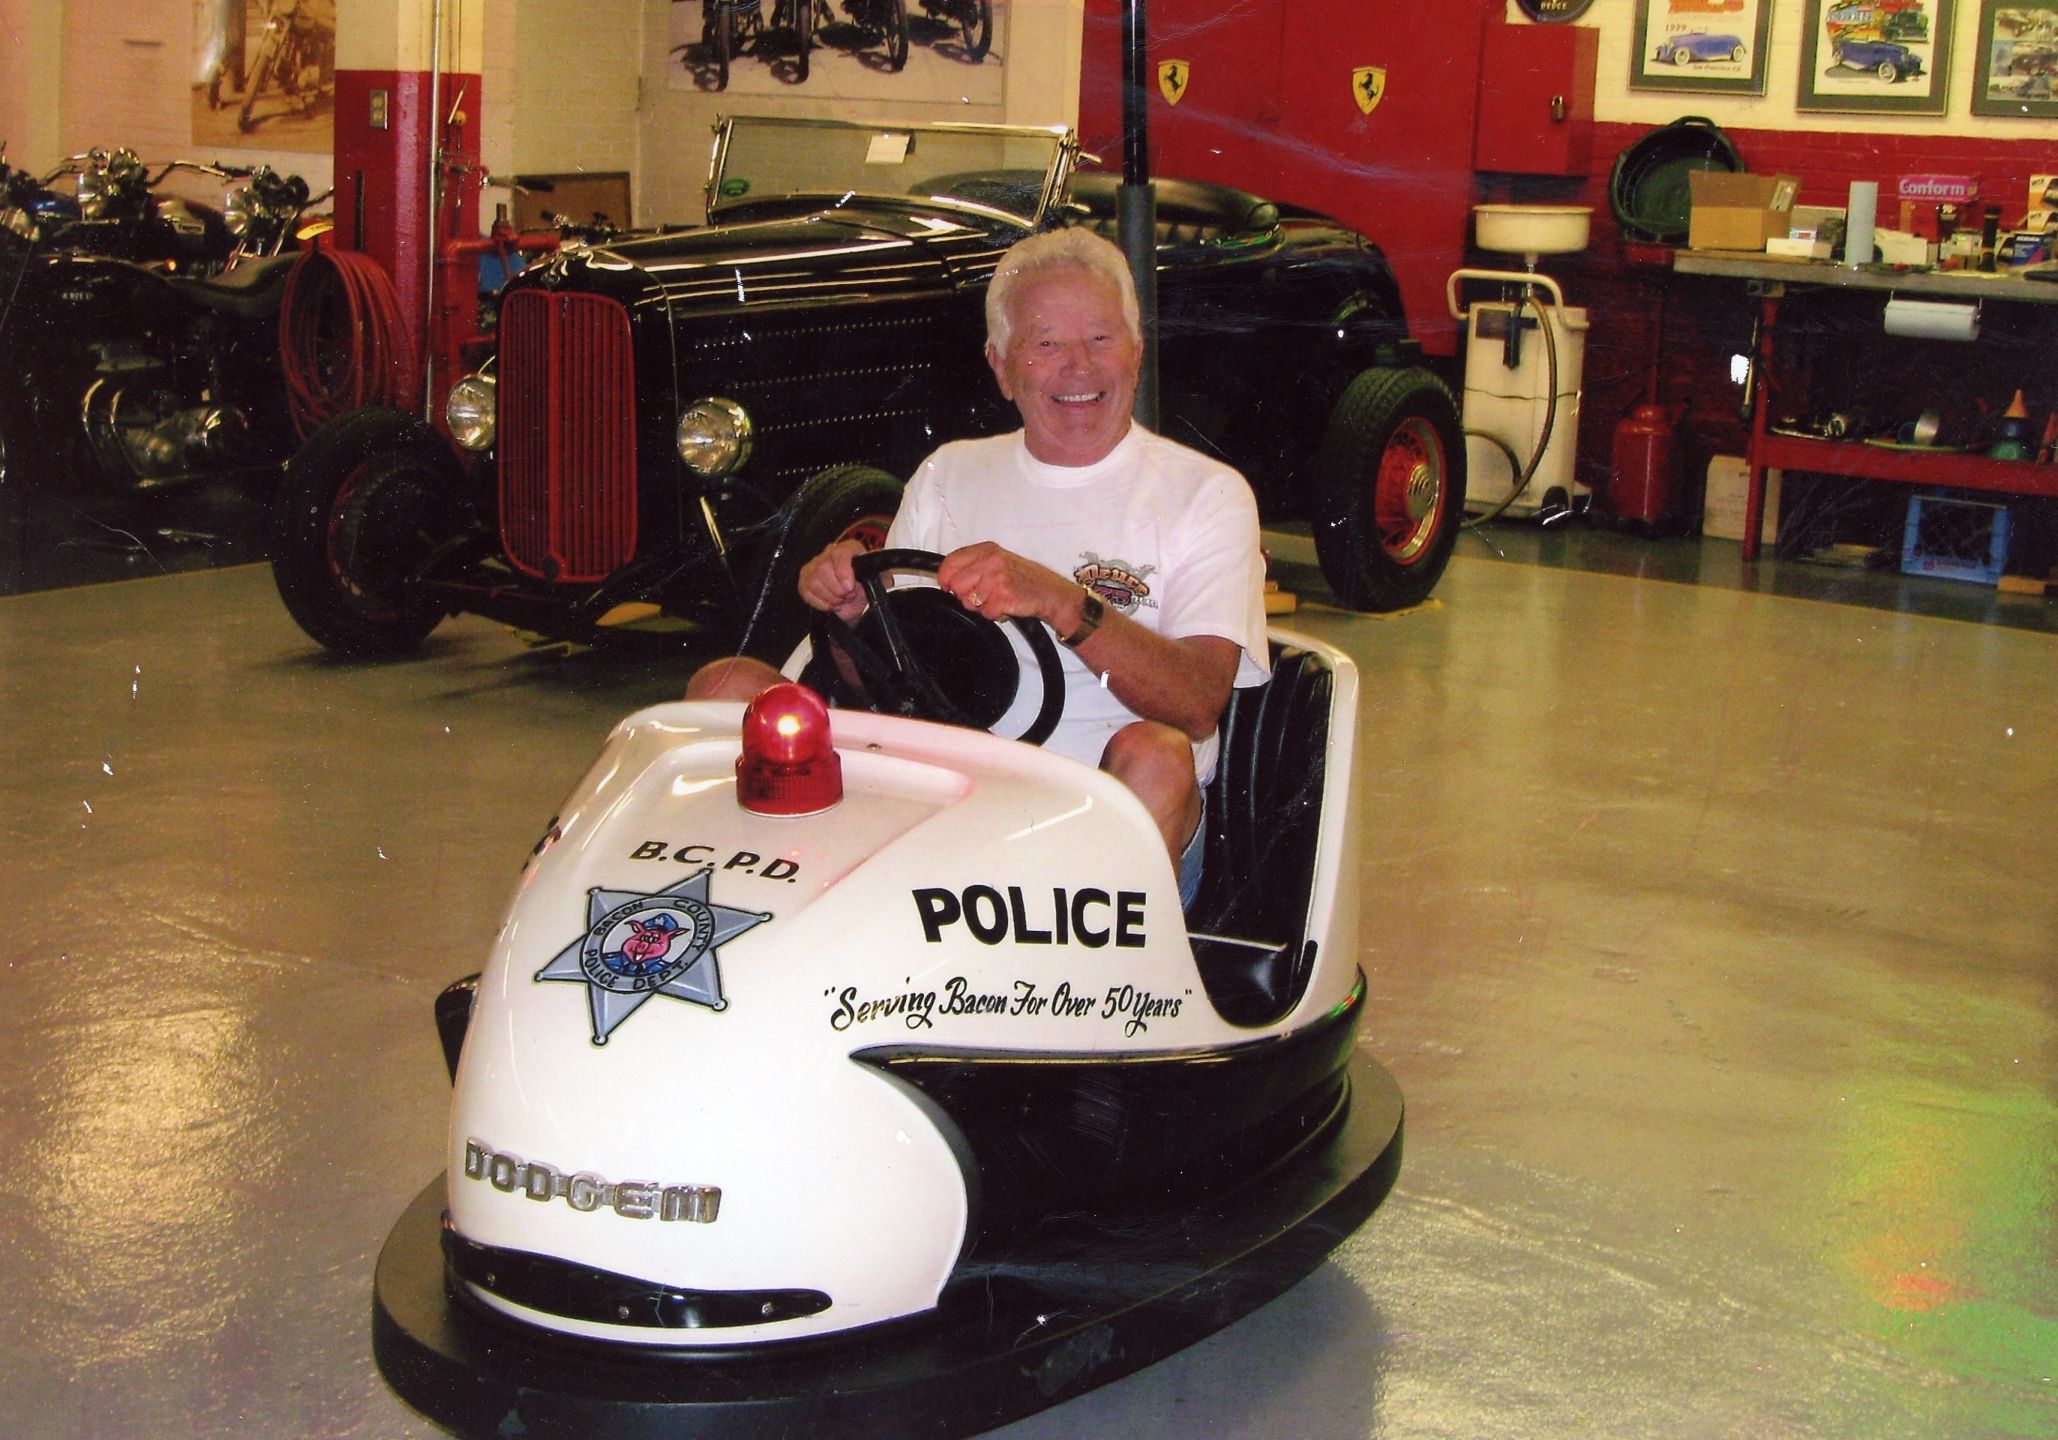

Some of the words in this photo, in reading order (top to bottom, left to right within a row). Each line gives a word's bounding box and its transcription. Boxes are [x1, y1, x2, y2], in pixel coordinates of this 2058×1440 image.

[1900, 179, 1966, 196] Conform
[629, 841, 799, 883] B.C.P.D.
[593, 901, 643, 936] BACON
[673, 899, 711, 951] COUNTY
[912, 884, 1147, 949] POLICE
[584, 949, 619, 988] POLICE
[632, 961, 688, 990] DEPT.
[938, 976, 1007, 1015] Bacon
[1010, 980, 1049, 1016] For
[1051, 982, 1096, 1017] Over
[1101, 984, 1134, 1020] 50
